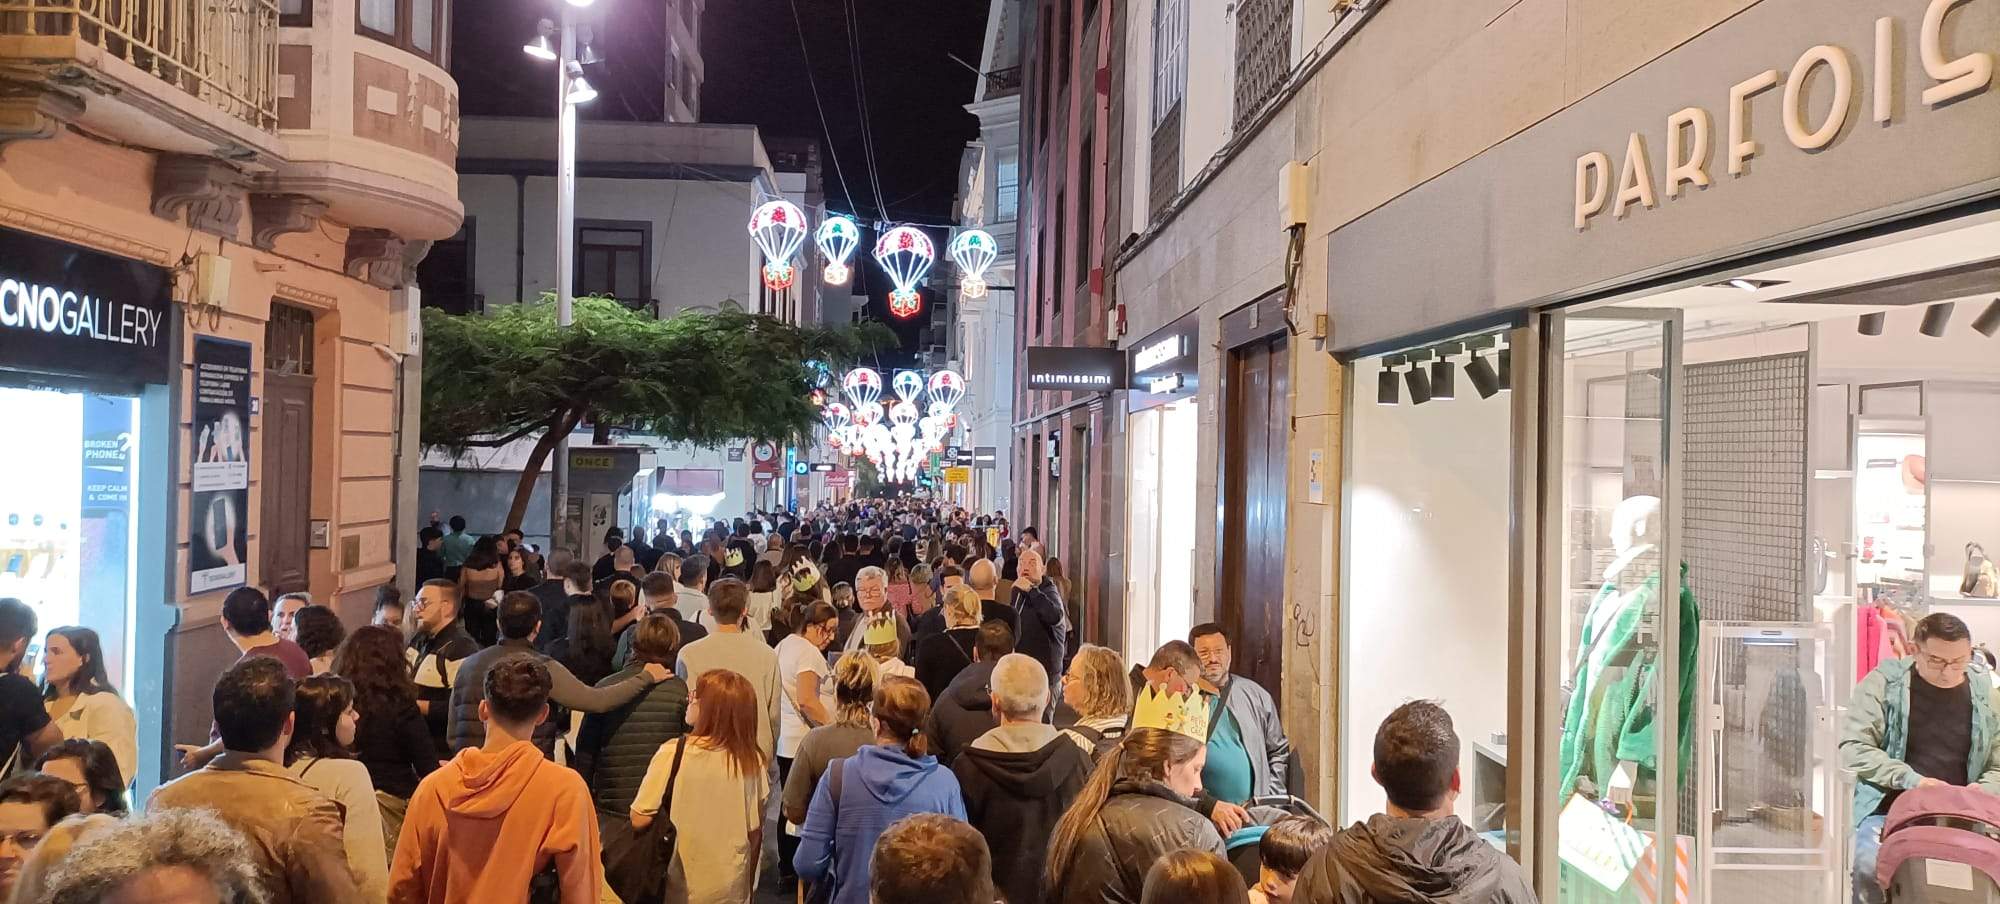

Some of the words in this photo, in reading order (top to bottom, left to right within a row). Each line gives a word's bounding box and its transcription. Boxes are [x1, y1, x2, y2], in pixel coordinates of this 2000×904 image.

[1574, 0, 1992, 229] PARFOIS
[1031, 374, 1111, 385] intimissimi
[84, 440, 119, 448] BROKEN
[575, 457, 609, 467] ONCE
[87, 484, 106, 492] KEEP
[107, 484, 128, 492] CALM
